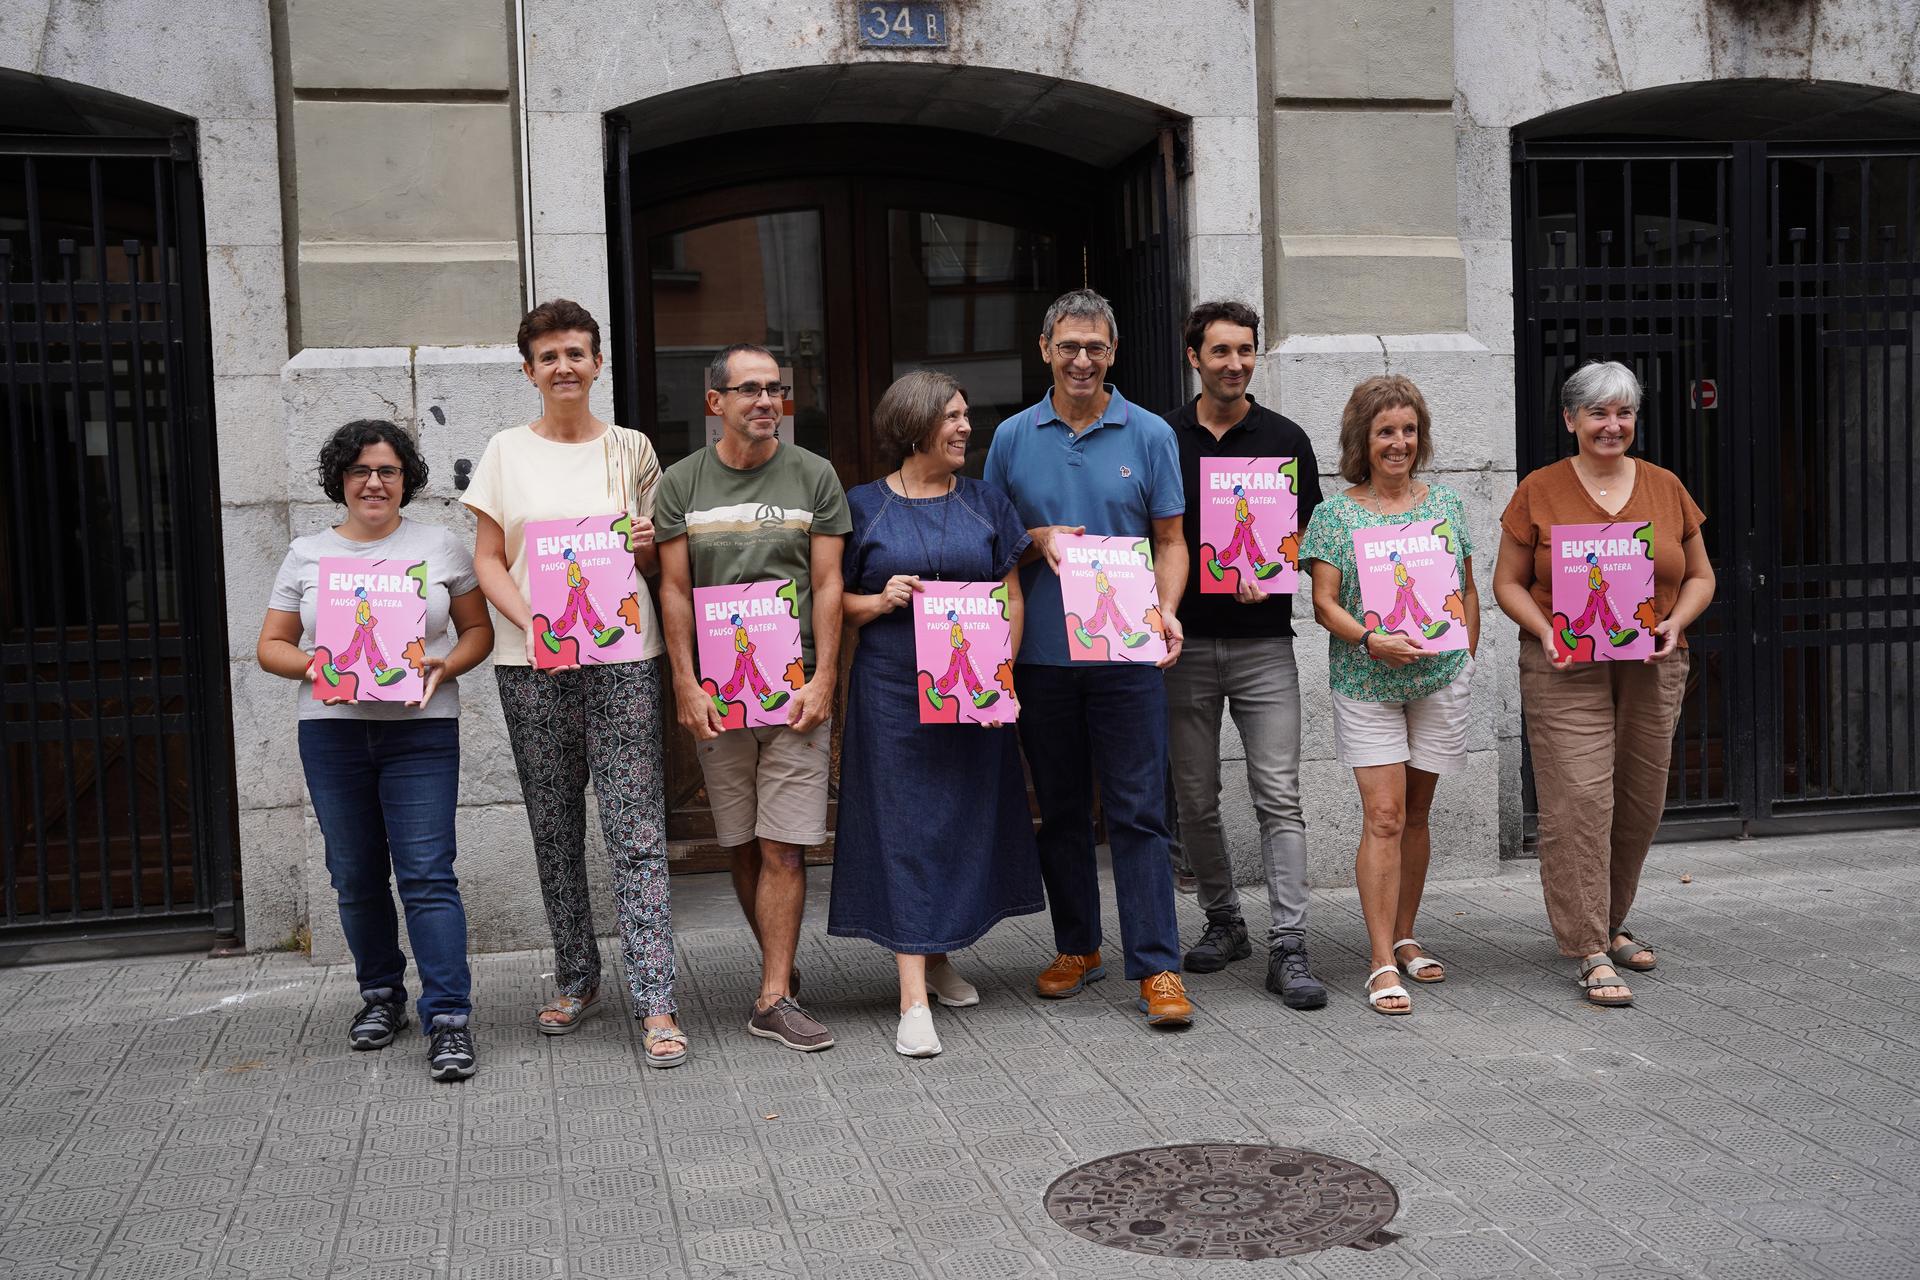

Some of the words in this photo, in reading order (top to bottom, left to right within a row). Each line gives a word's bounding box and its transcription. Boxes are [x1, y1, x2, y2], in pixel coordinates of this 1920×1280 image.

[867, 6, 914, 39] 34
[1210, 472, 1286, 490] EUSKARA
[1212, 496, 1235, 504] PAUSO
[1249, 496, 1277, 504] BATERA
[537, 530, 620, 556] EUSKARA
[1364, 534, 1442, 559] EUSKARA
[1561, 538, 1642, 558] EUSKARA
[541, 562, 566, 571] PAUSO
[581, 557, 611, 568] BATERA
[1066, 547, 1142, 566] EUSKARA
[1369, 563, 1393, 573] PAUSO
[1406, 558, 1434, 569] BATERA
[1071, 569, 1094, 578] PAUSO
[1108, 570, 1135, 579] BATERA
[1564, 565, 1588, 573] PAUSO
[1603, 563, 1632, 571] BATERA
[329, 573, 414, 593] EUSKARA
[330, 599, 356, 607] PAUSO
[372, 599, 404, 607] BATERA
[705, 597, 786, 621] EUSKARA
[923, 597, 999, 615] EUSKARA
[709, 628, 733, 636] PAUSO
[748, 623, 778, 633] BATERA
[927, 622, 950, 630] PAUSO
[964, 622, 990, 630] BATERA
